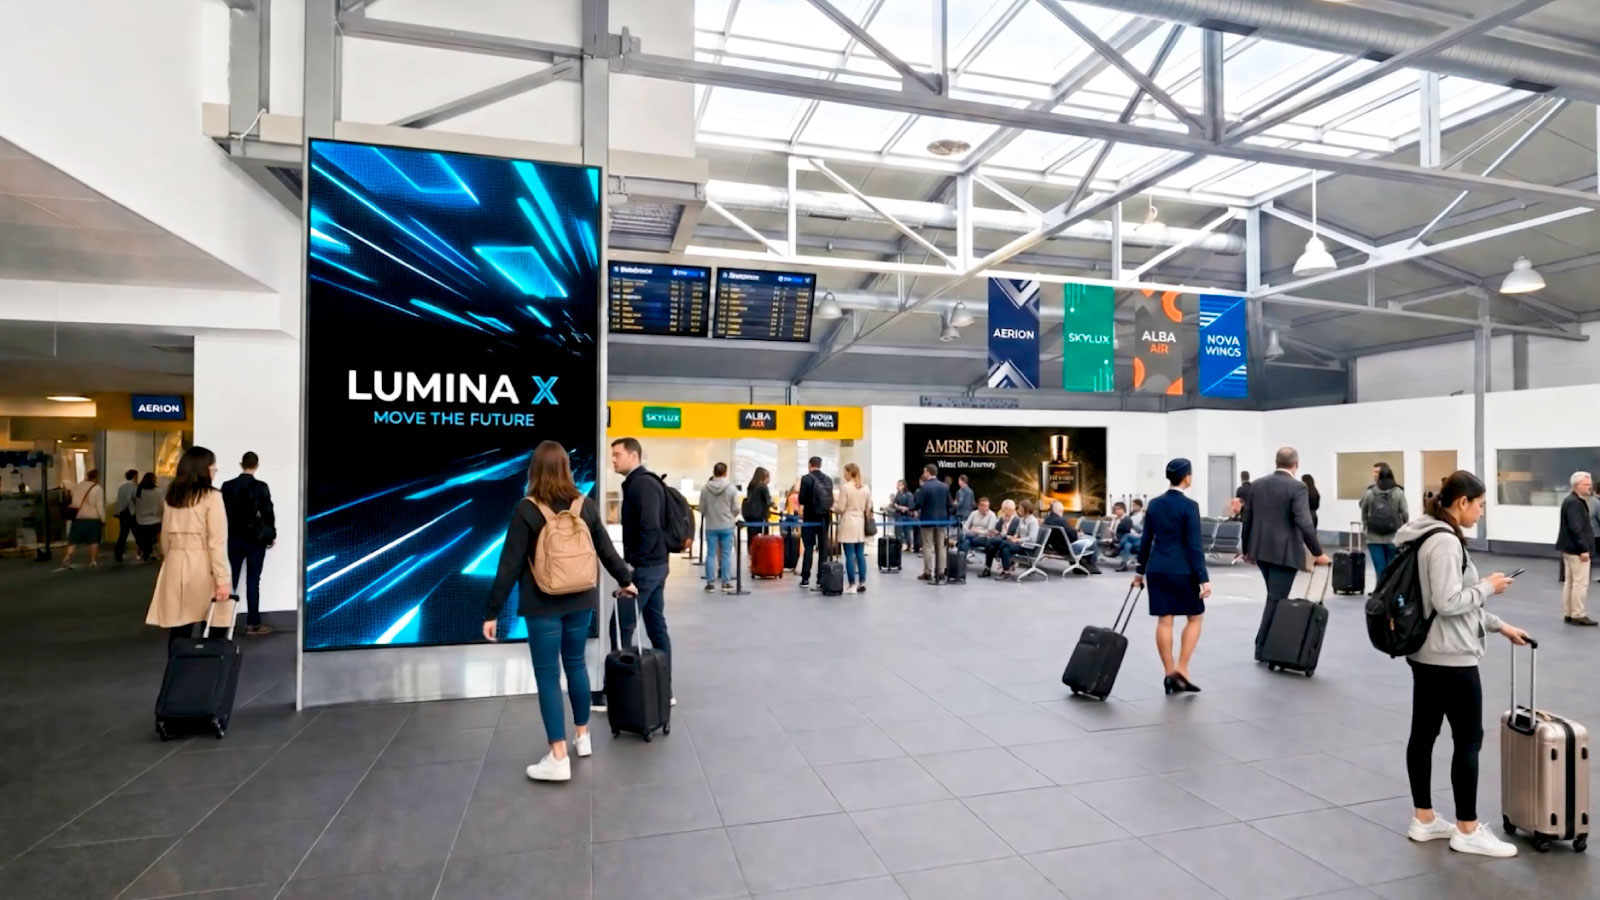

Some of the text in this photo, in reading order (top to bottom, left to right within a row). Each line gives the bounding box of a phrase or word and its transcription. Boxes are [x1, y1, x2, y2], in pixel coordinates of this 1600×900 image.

[993, 328, 1035, 339] AERION
[1068, 333, 1110, 345] SKYLUX
[1141, 330, 1177, 343] ALBA
[1207, 335, 1240, 346] NOVA
[1149, 343, 1169, 354] AIR
[1205, 346, 1242, 357] WINGS
[348, 370, 559, 405] LUMINA X
[138, 403, 180, 413] AERION
[374, 411, 535, 427] MOVE THE FUTURE
[645, 413, 680, 422] SKYLUX
[745, 411, 772, 420] ALBA
[924, 439, 1009, 454] AMBRE NOIR
